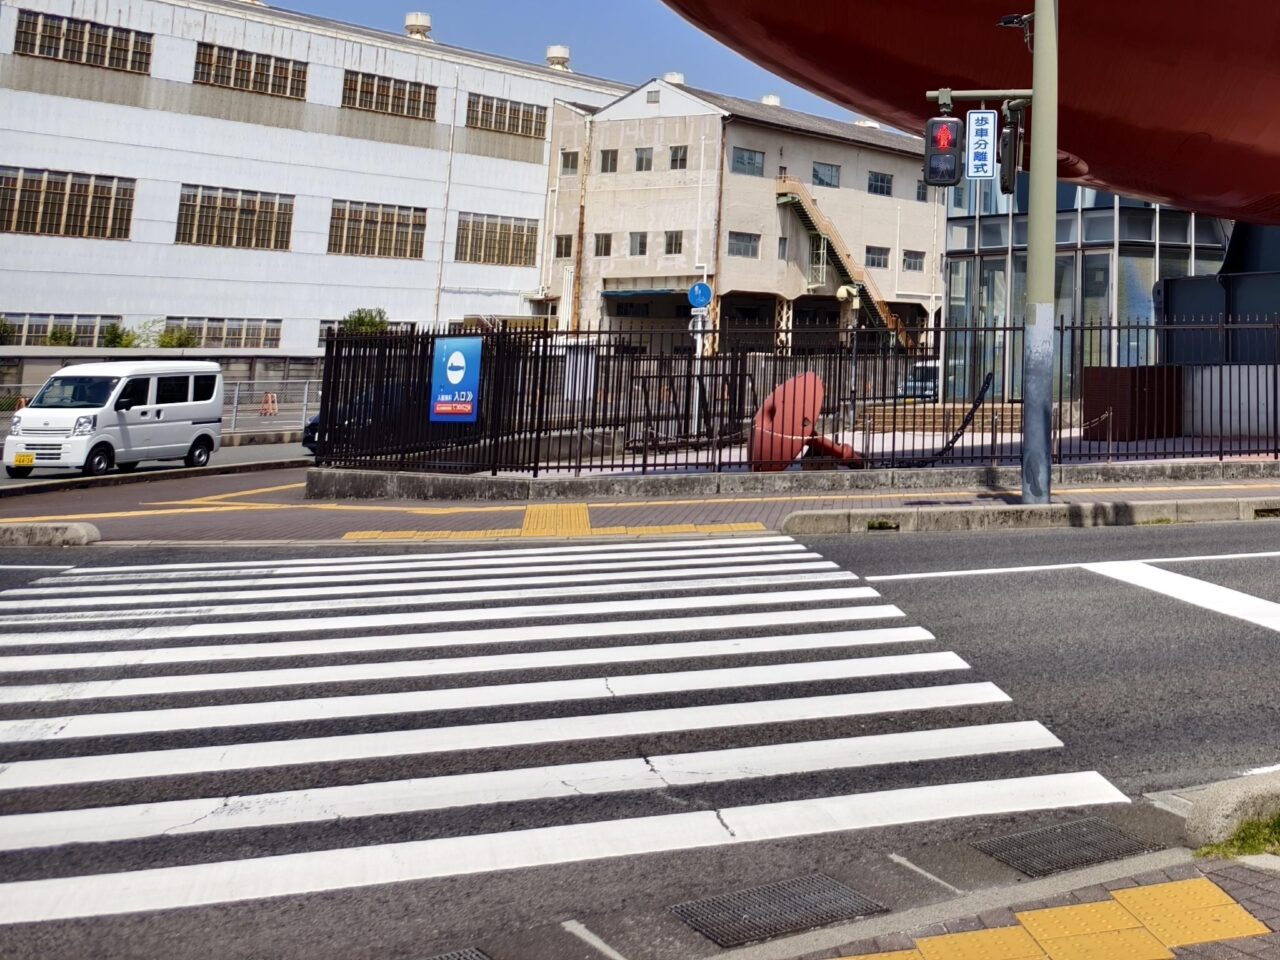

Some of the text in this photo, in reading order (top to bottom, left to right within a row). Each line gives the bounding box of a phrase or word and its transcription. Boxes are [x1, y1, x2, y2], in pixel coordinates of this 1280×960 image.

[973, 116, 989, 174] 歩車分離式
